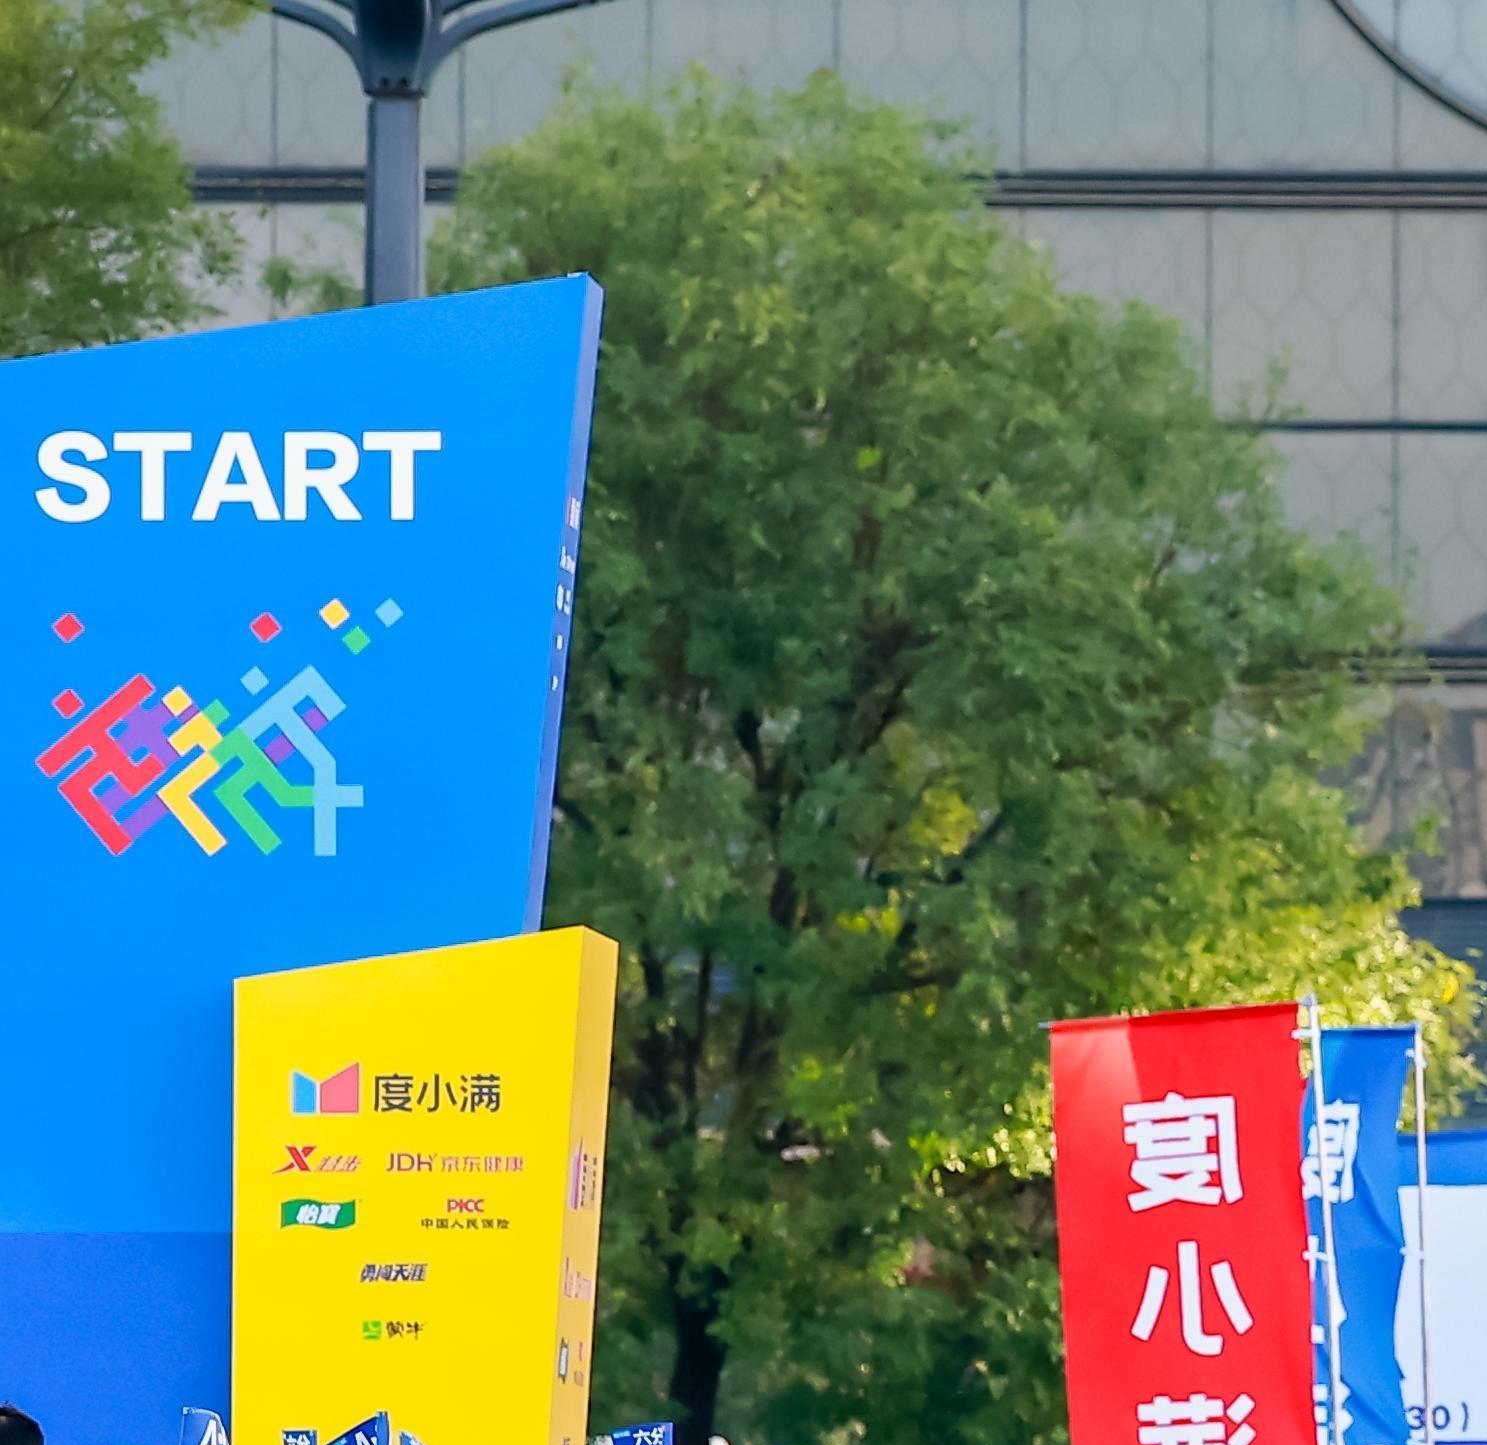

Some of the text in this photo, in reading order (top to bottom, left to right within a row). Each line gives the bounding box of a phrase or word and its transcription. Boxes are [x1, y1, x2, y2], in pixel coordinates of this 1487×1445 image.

[35, 431, 442, 523] START
[373, 1073, 501, 1113] 度小满
[441, 1155, 524, 1173] 京东健康
[446, 1199, 485, 1213] PICC
[420, 1218, 510, 1231] 中国人民保险
[359, 1262, 428, 1283] 勇闯天涯
